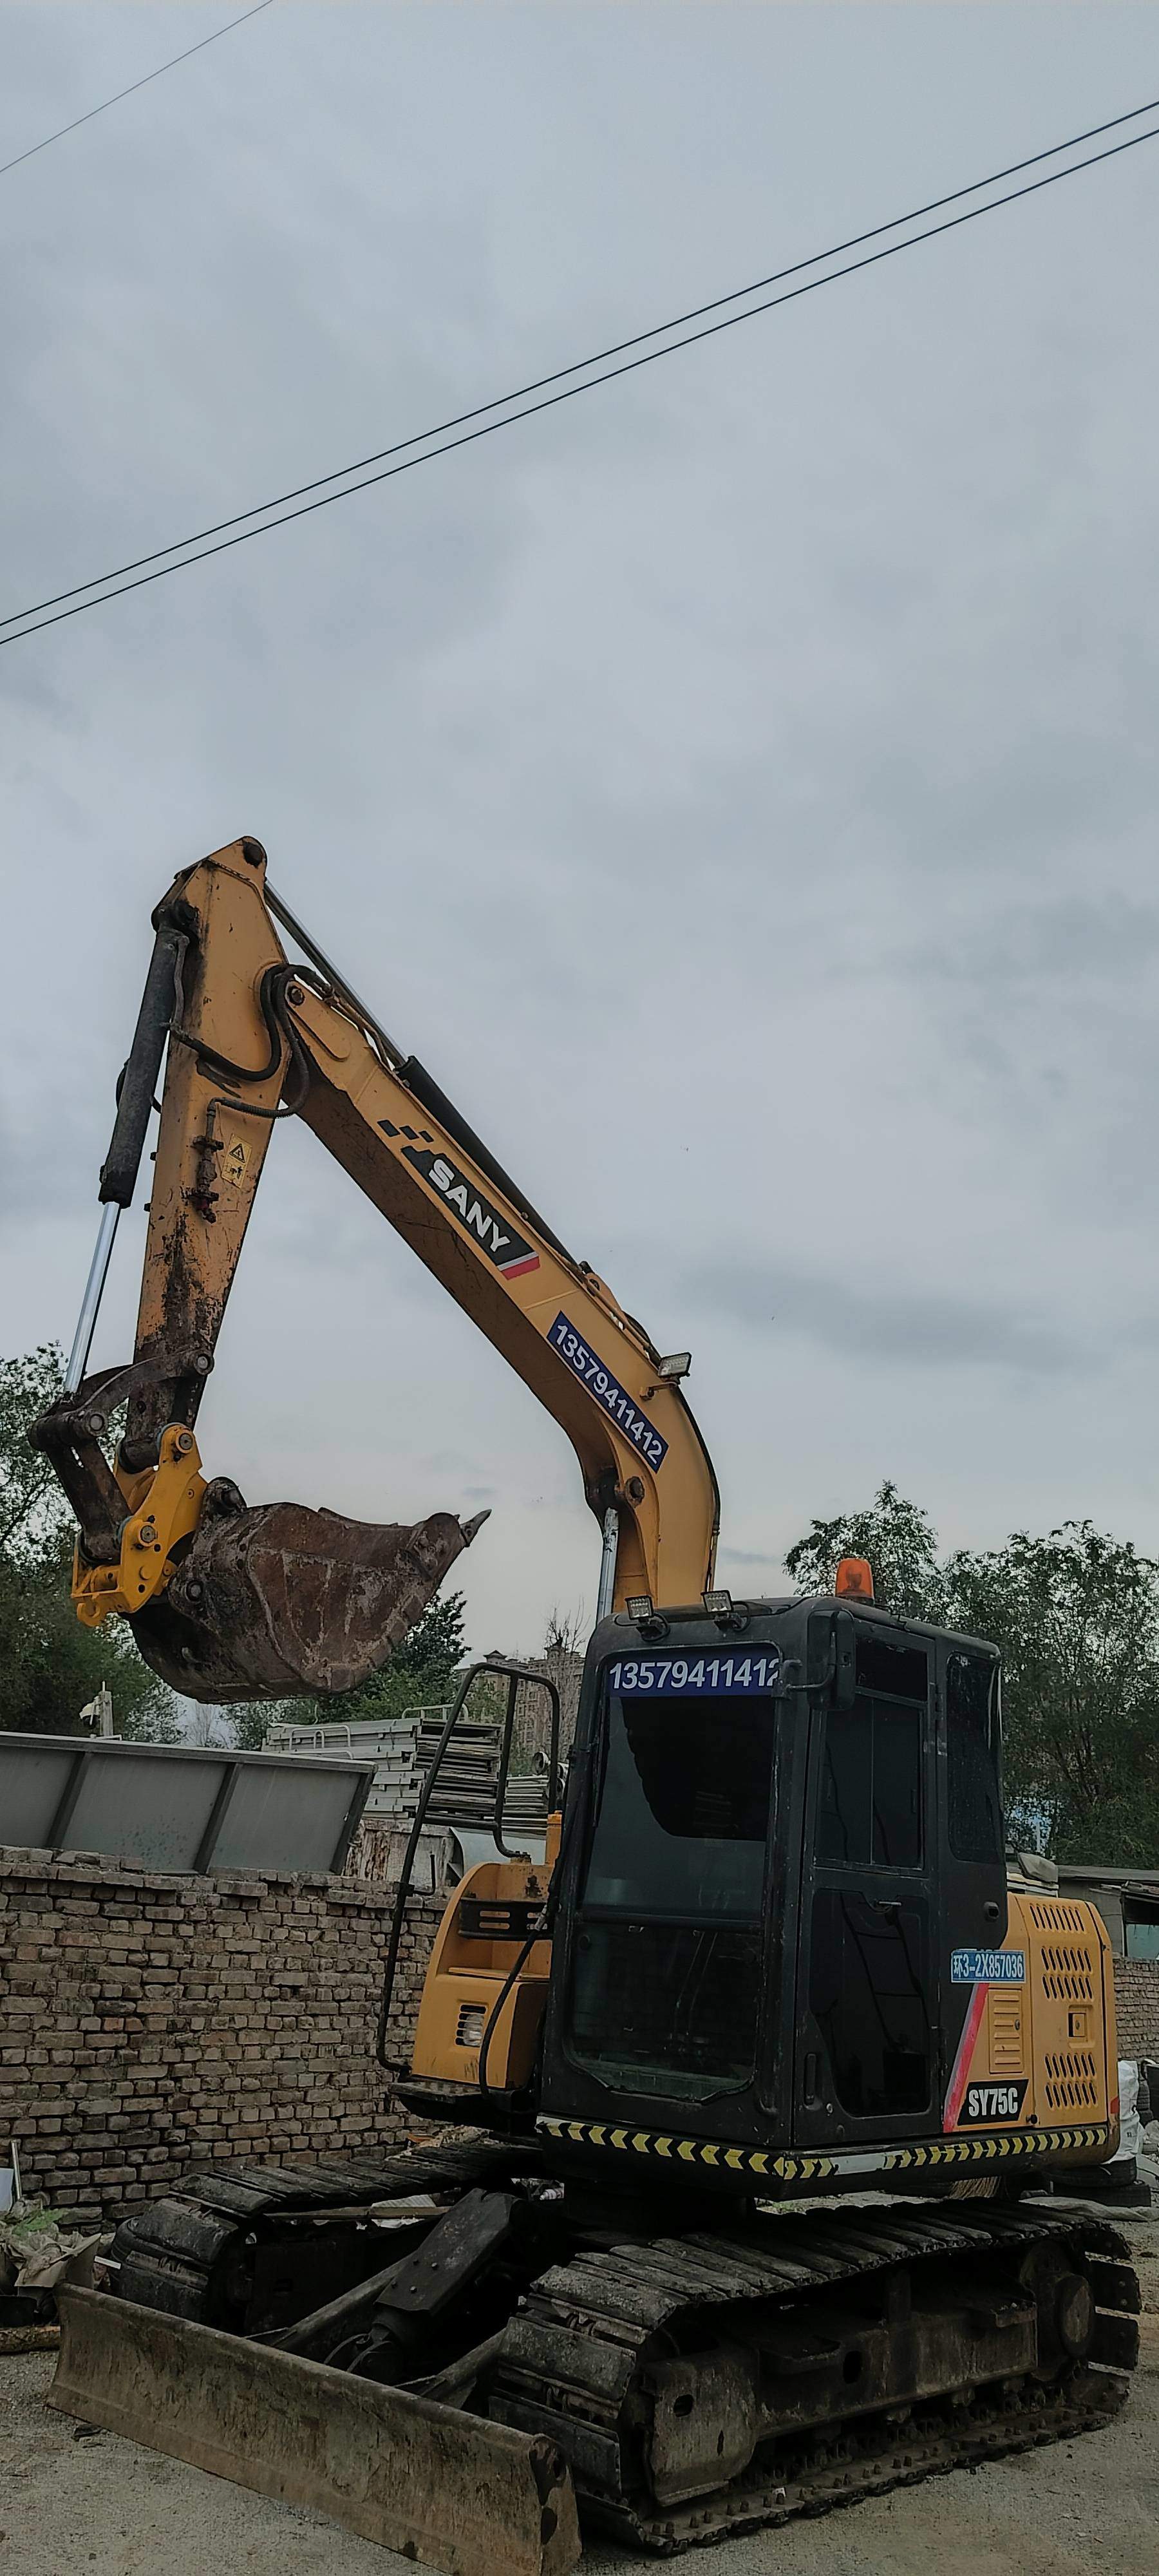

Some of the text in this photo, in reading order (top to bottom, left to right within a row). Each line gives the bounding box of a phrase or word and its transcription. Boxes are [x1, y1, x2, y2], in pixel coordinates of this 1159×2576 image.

[428, 1159, 510, 1253] SANY
[556, 1323, 662, 1464] 13579411412
[953, 1953, 1022, 1978] 环3-2X857036
[968, 2088, 1018, 2117] SY75C
